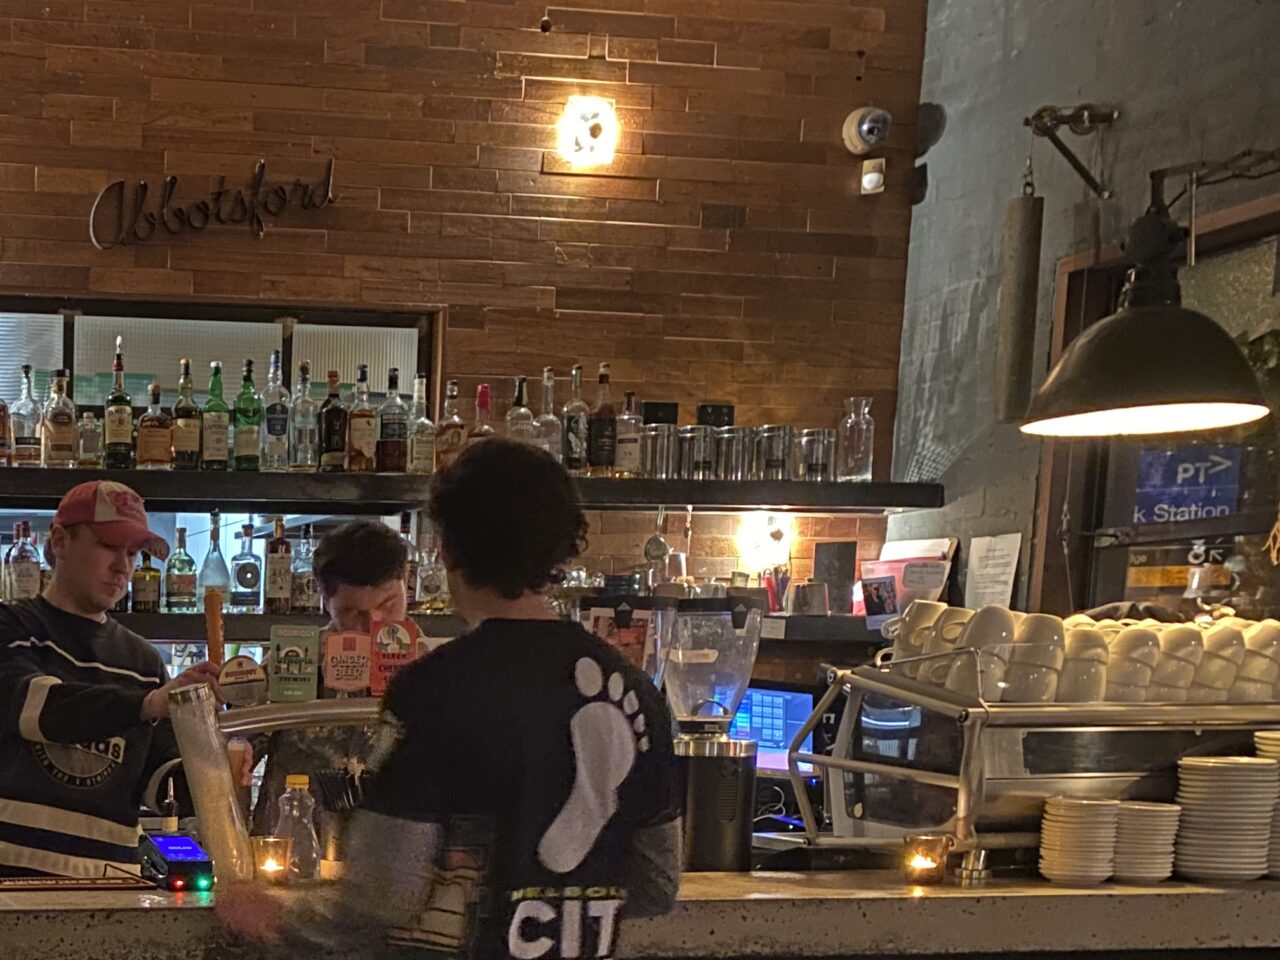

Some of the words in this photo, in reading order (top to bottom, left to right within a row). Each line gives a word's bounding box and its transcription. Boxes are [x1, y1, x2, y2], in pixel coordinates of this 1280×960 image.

[89, 158, 340, 251] Abbotsford
[1153, 502, 1229, 523] Station
[329, 653, 369, 668] GINGER
[335, 666, 365, 681] BEER
